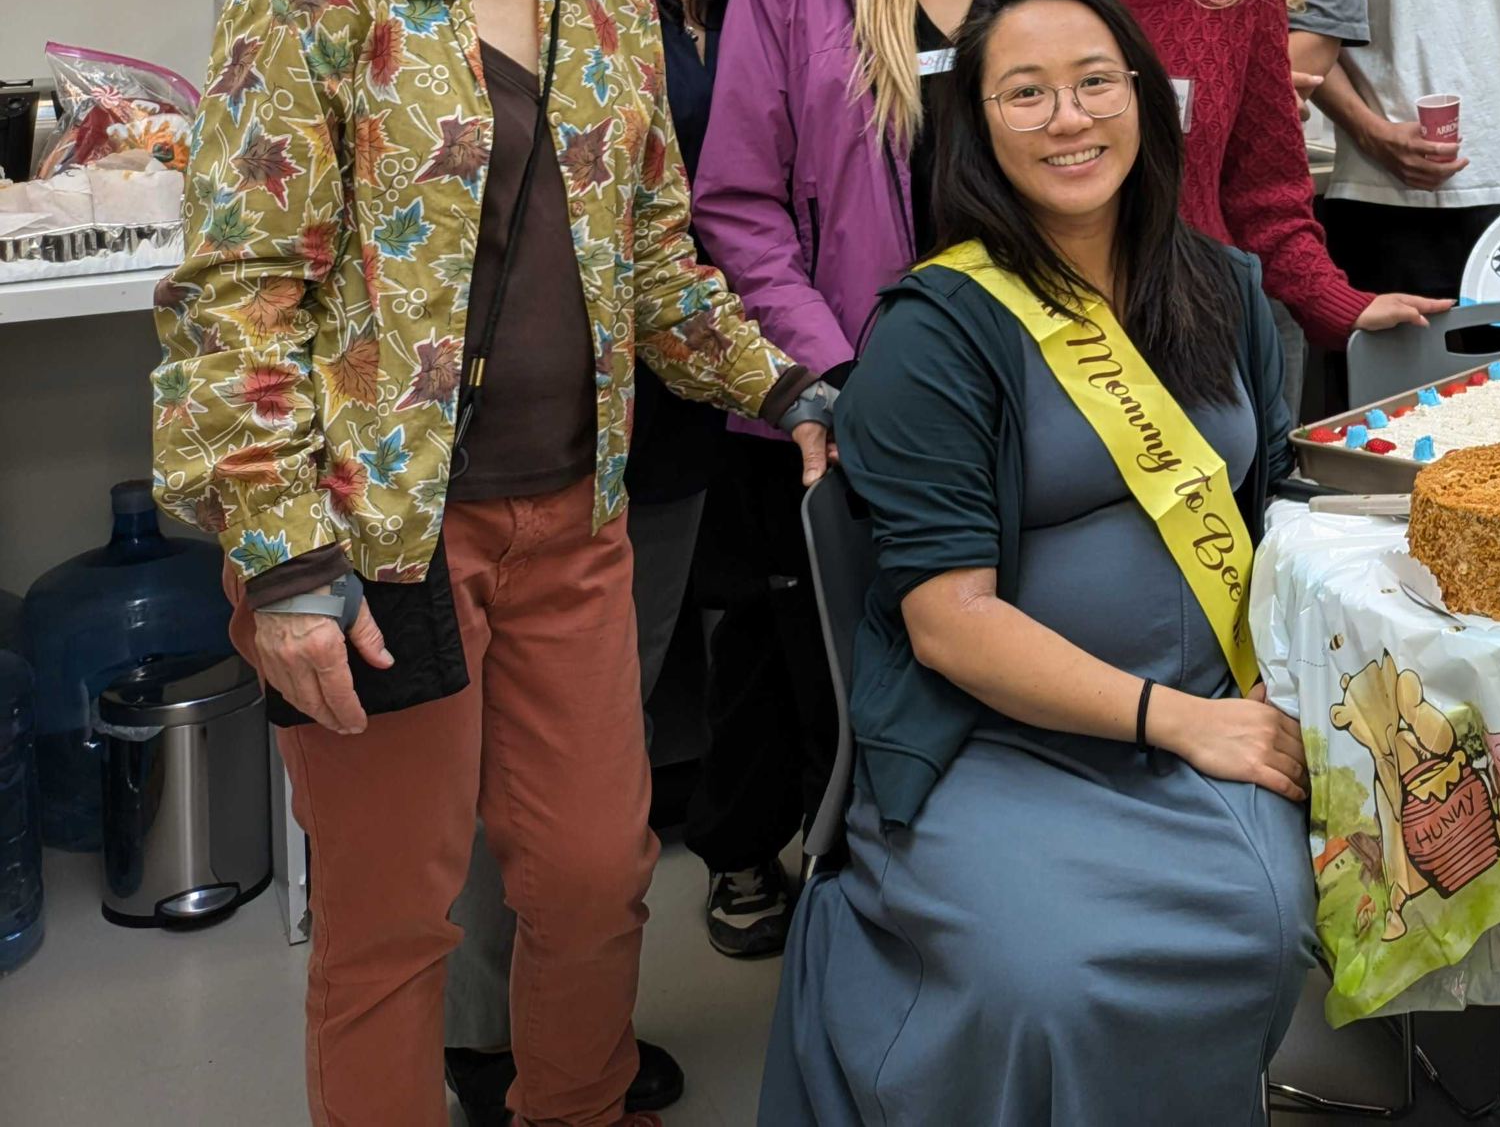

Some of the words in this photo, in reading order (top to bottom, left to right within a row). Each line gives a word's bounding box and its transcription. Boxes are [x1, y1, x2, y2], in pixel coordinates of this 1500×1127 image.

[1066, 318, 1182, 473] Mommy
[1174, 466, 1212, 513] to
[1191, 512, 1242, 602] Bee
[1415, 787, 1474, 849] HUNNY
